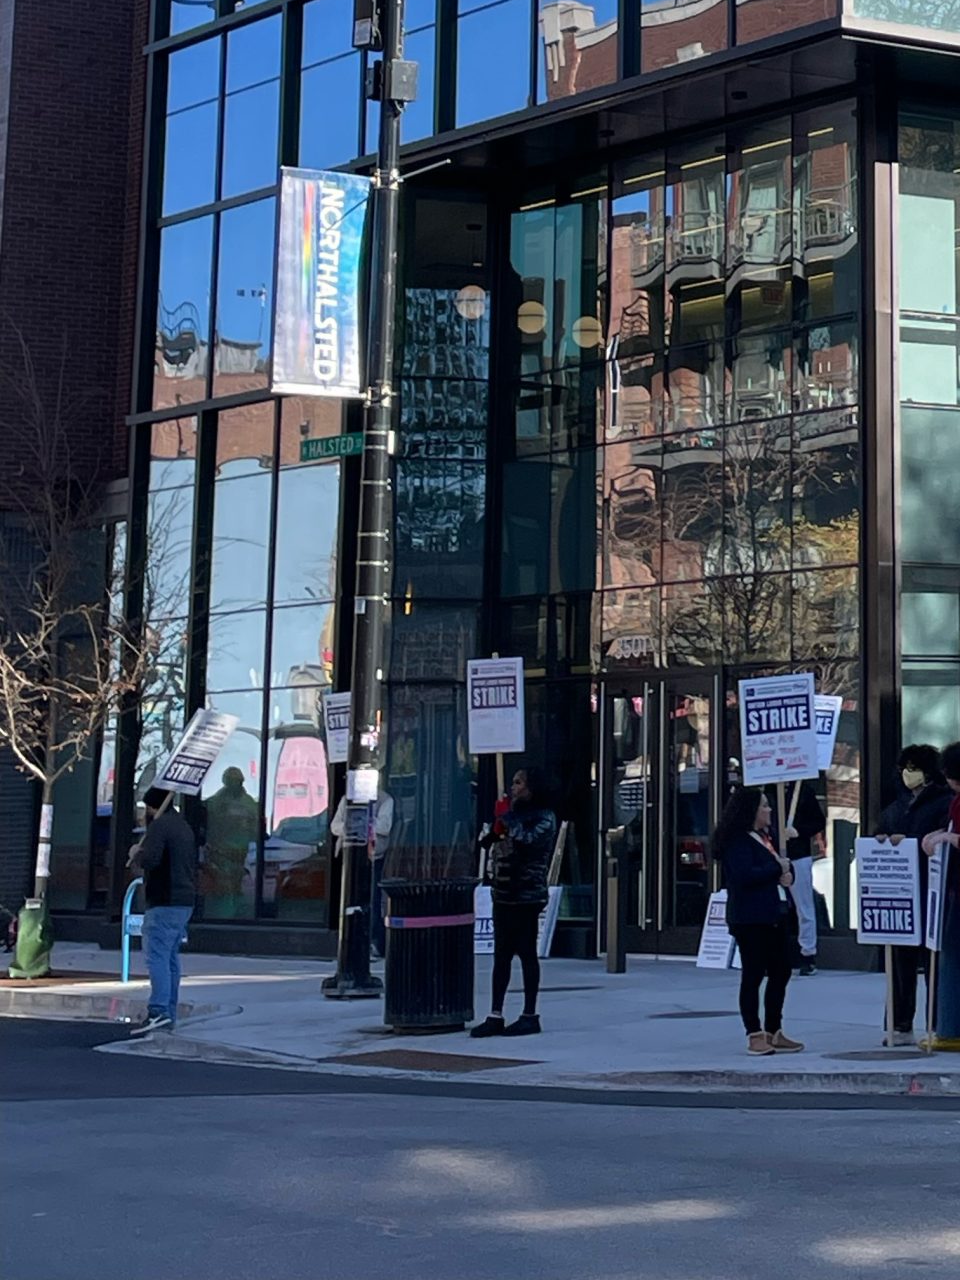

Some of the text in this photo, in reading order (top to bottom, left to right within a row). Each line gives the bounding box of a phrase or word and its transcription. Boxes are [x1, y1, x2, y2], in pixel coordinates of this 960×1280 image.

[313, 185, 345, 382] NORTHALSTED
[309, 436, 354, 458] HALSTED
[472, 685, 516, 708] STRIKE
[748, 705, 809, 732] STRIKE
[863, 908, 912, 931] STRIKE
